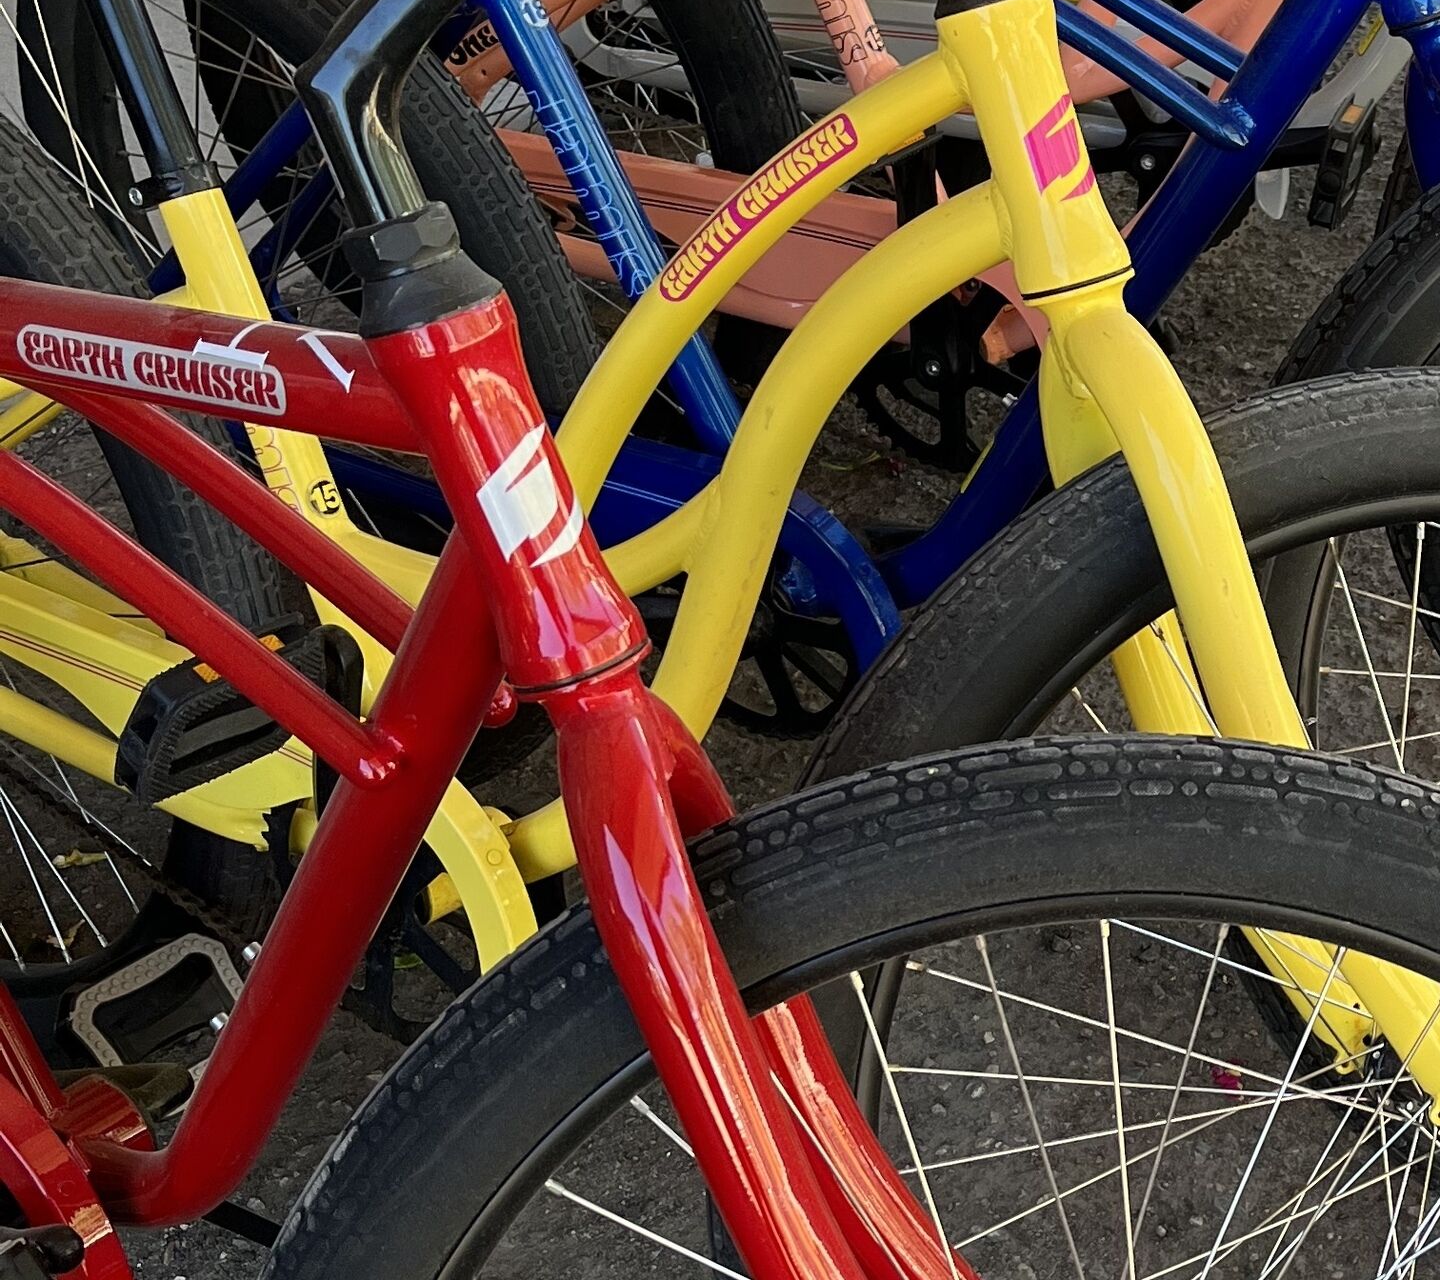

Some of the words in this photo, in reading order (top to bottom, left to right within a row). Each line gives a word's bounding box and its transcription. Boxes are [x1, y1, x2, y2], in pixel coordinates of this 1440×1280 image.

[661, 207, 742, 299] EARTH
[736, 117, 855, 220] CRUISER
[23, 330, 128, 381] EARTH
[133, 351, 281, 409] CRUISER
[310, 481, 341, 513] 15
